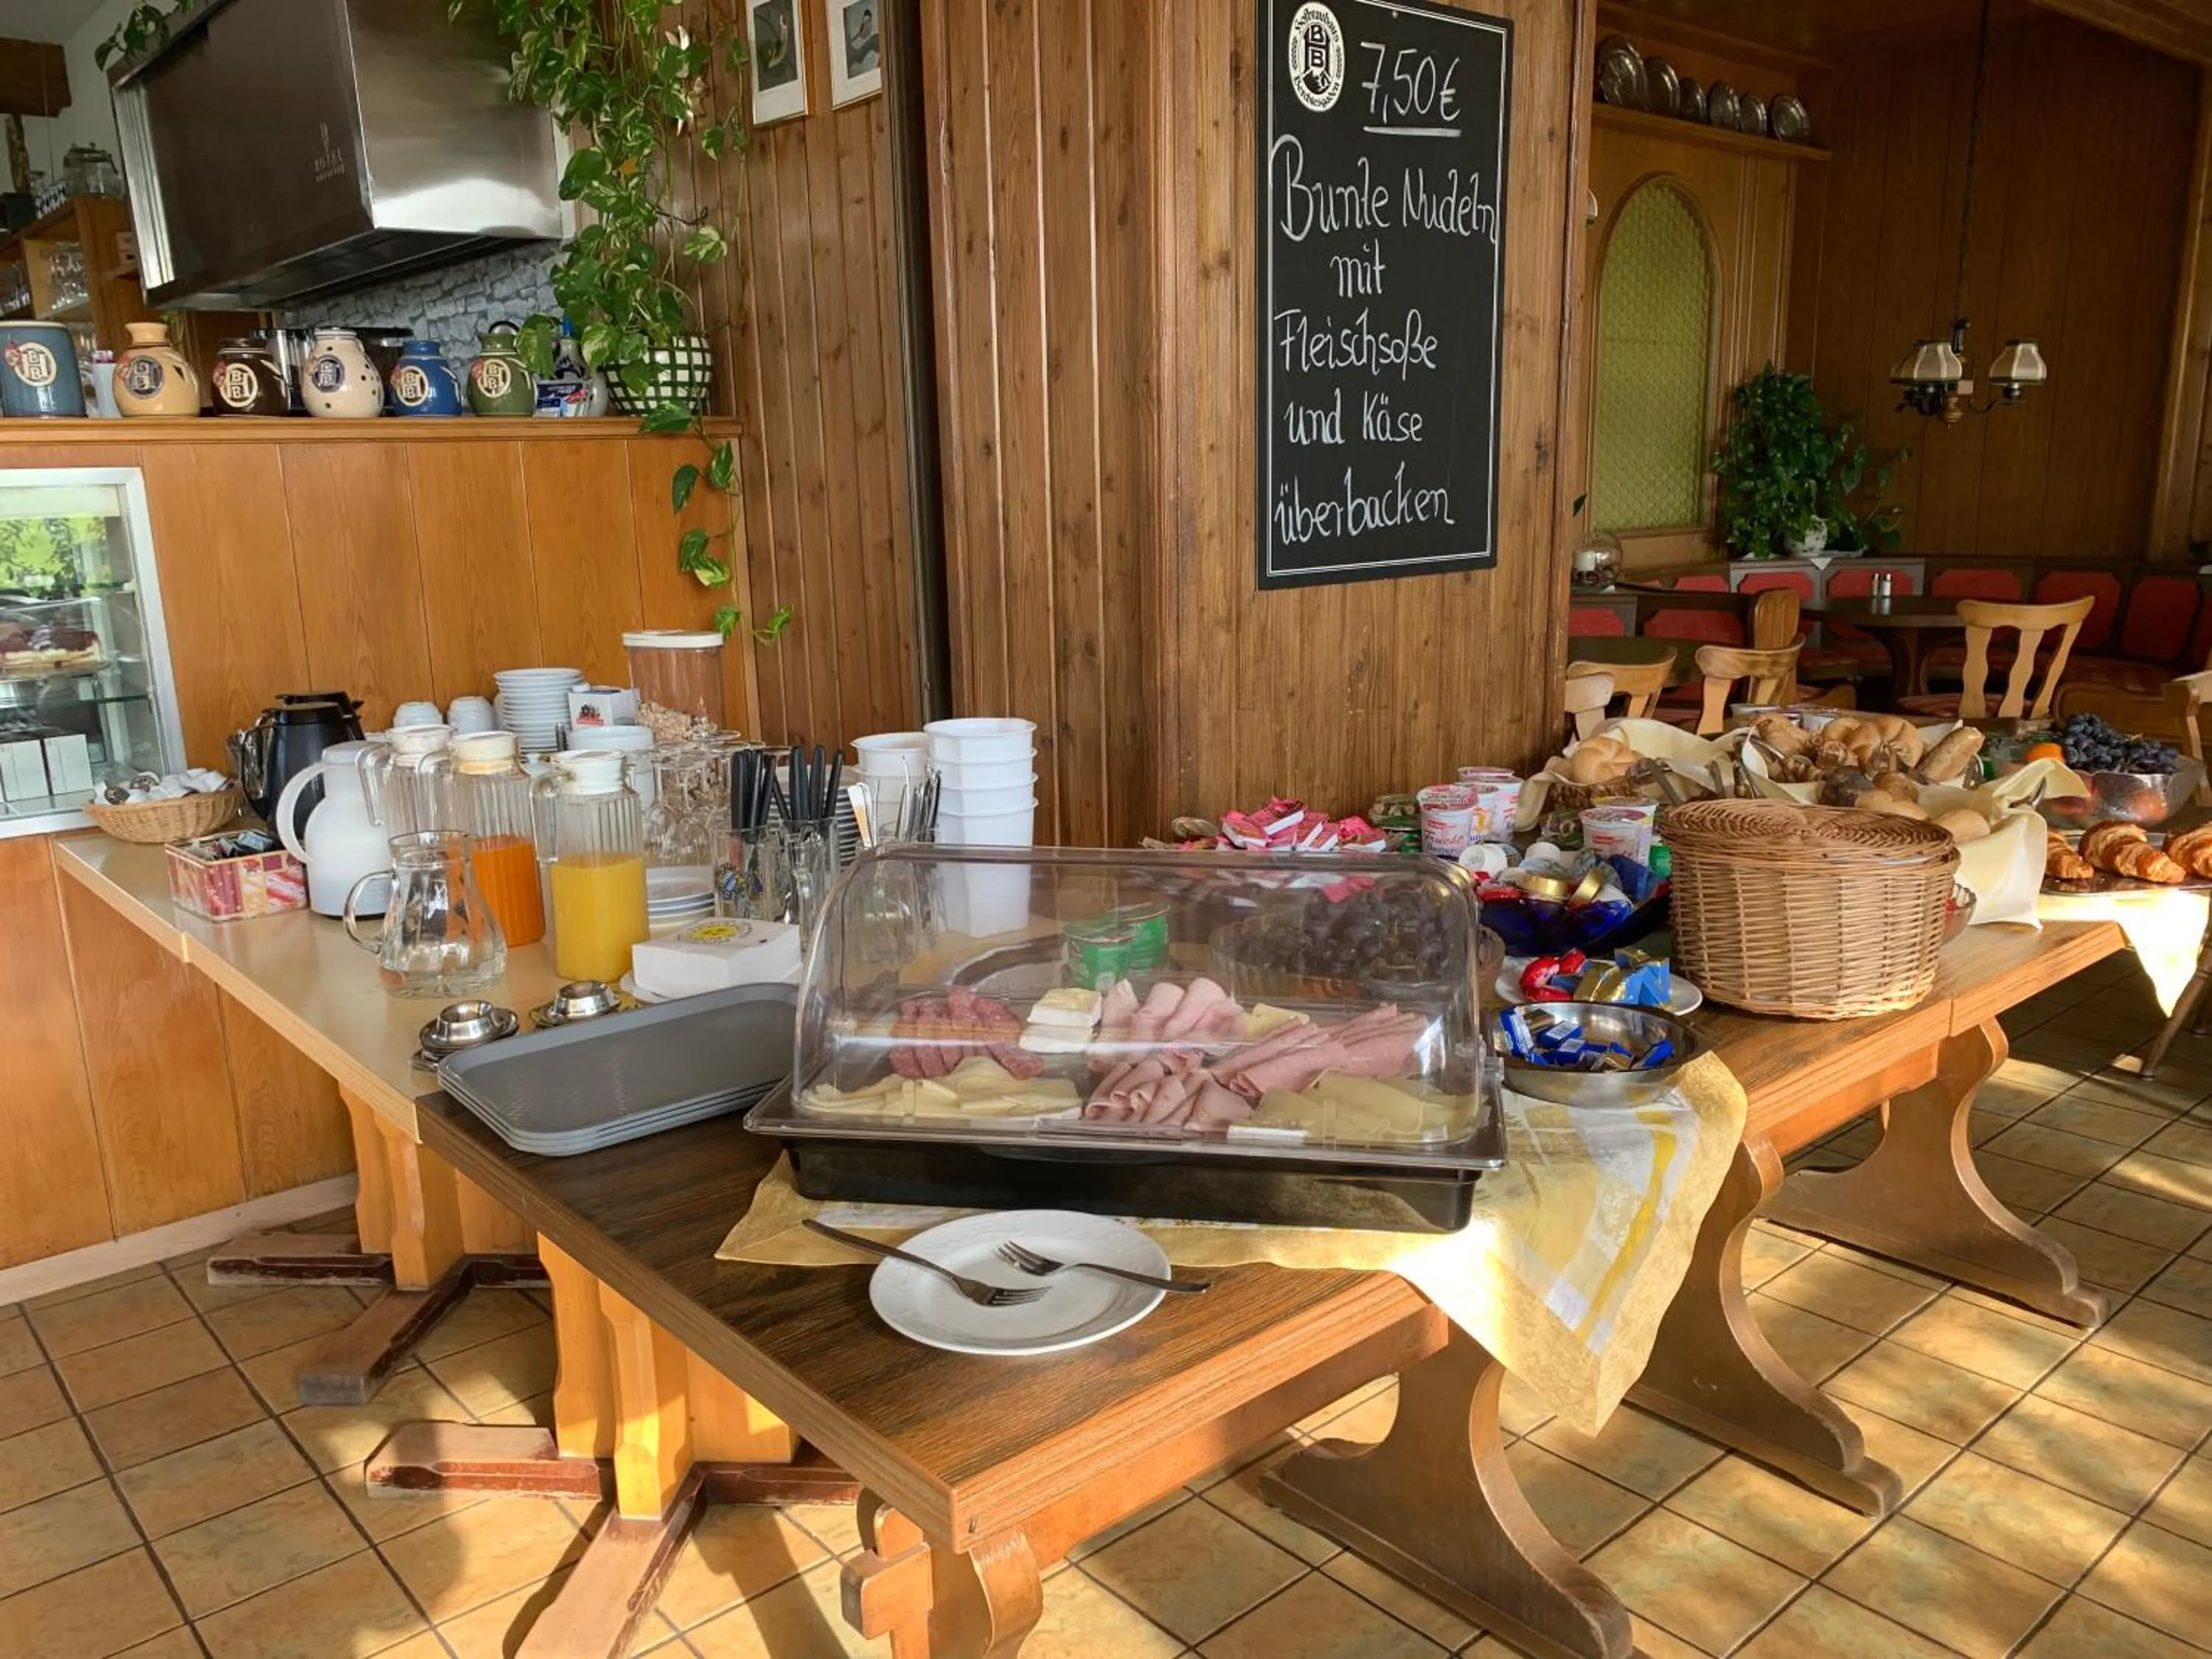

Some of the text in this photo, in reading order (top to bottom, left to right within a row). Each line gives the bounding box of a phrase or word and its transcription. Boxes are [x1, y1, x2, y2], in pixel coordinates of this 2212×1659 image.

[1360, 42, 1461, 124] 7,50€
[1269, 134, 1496, 244] Bunte Nudeln
[1330, 237, 1386, 298] mit
[1273, 307, 1438, 381] Fleischsoße
[1284, 387, 1423, 445] und Käse
[1274, 460, 1456, 546] überbacken
